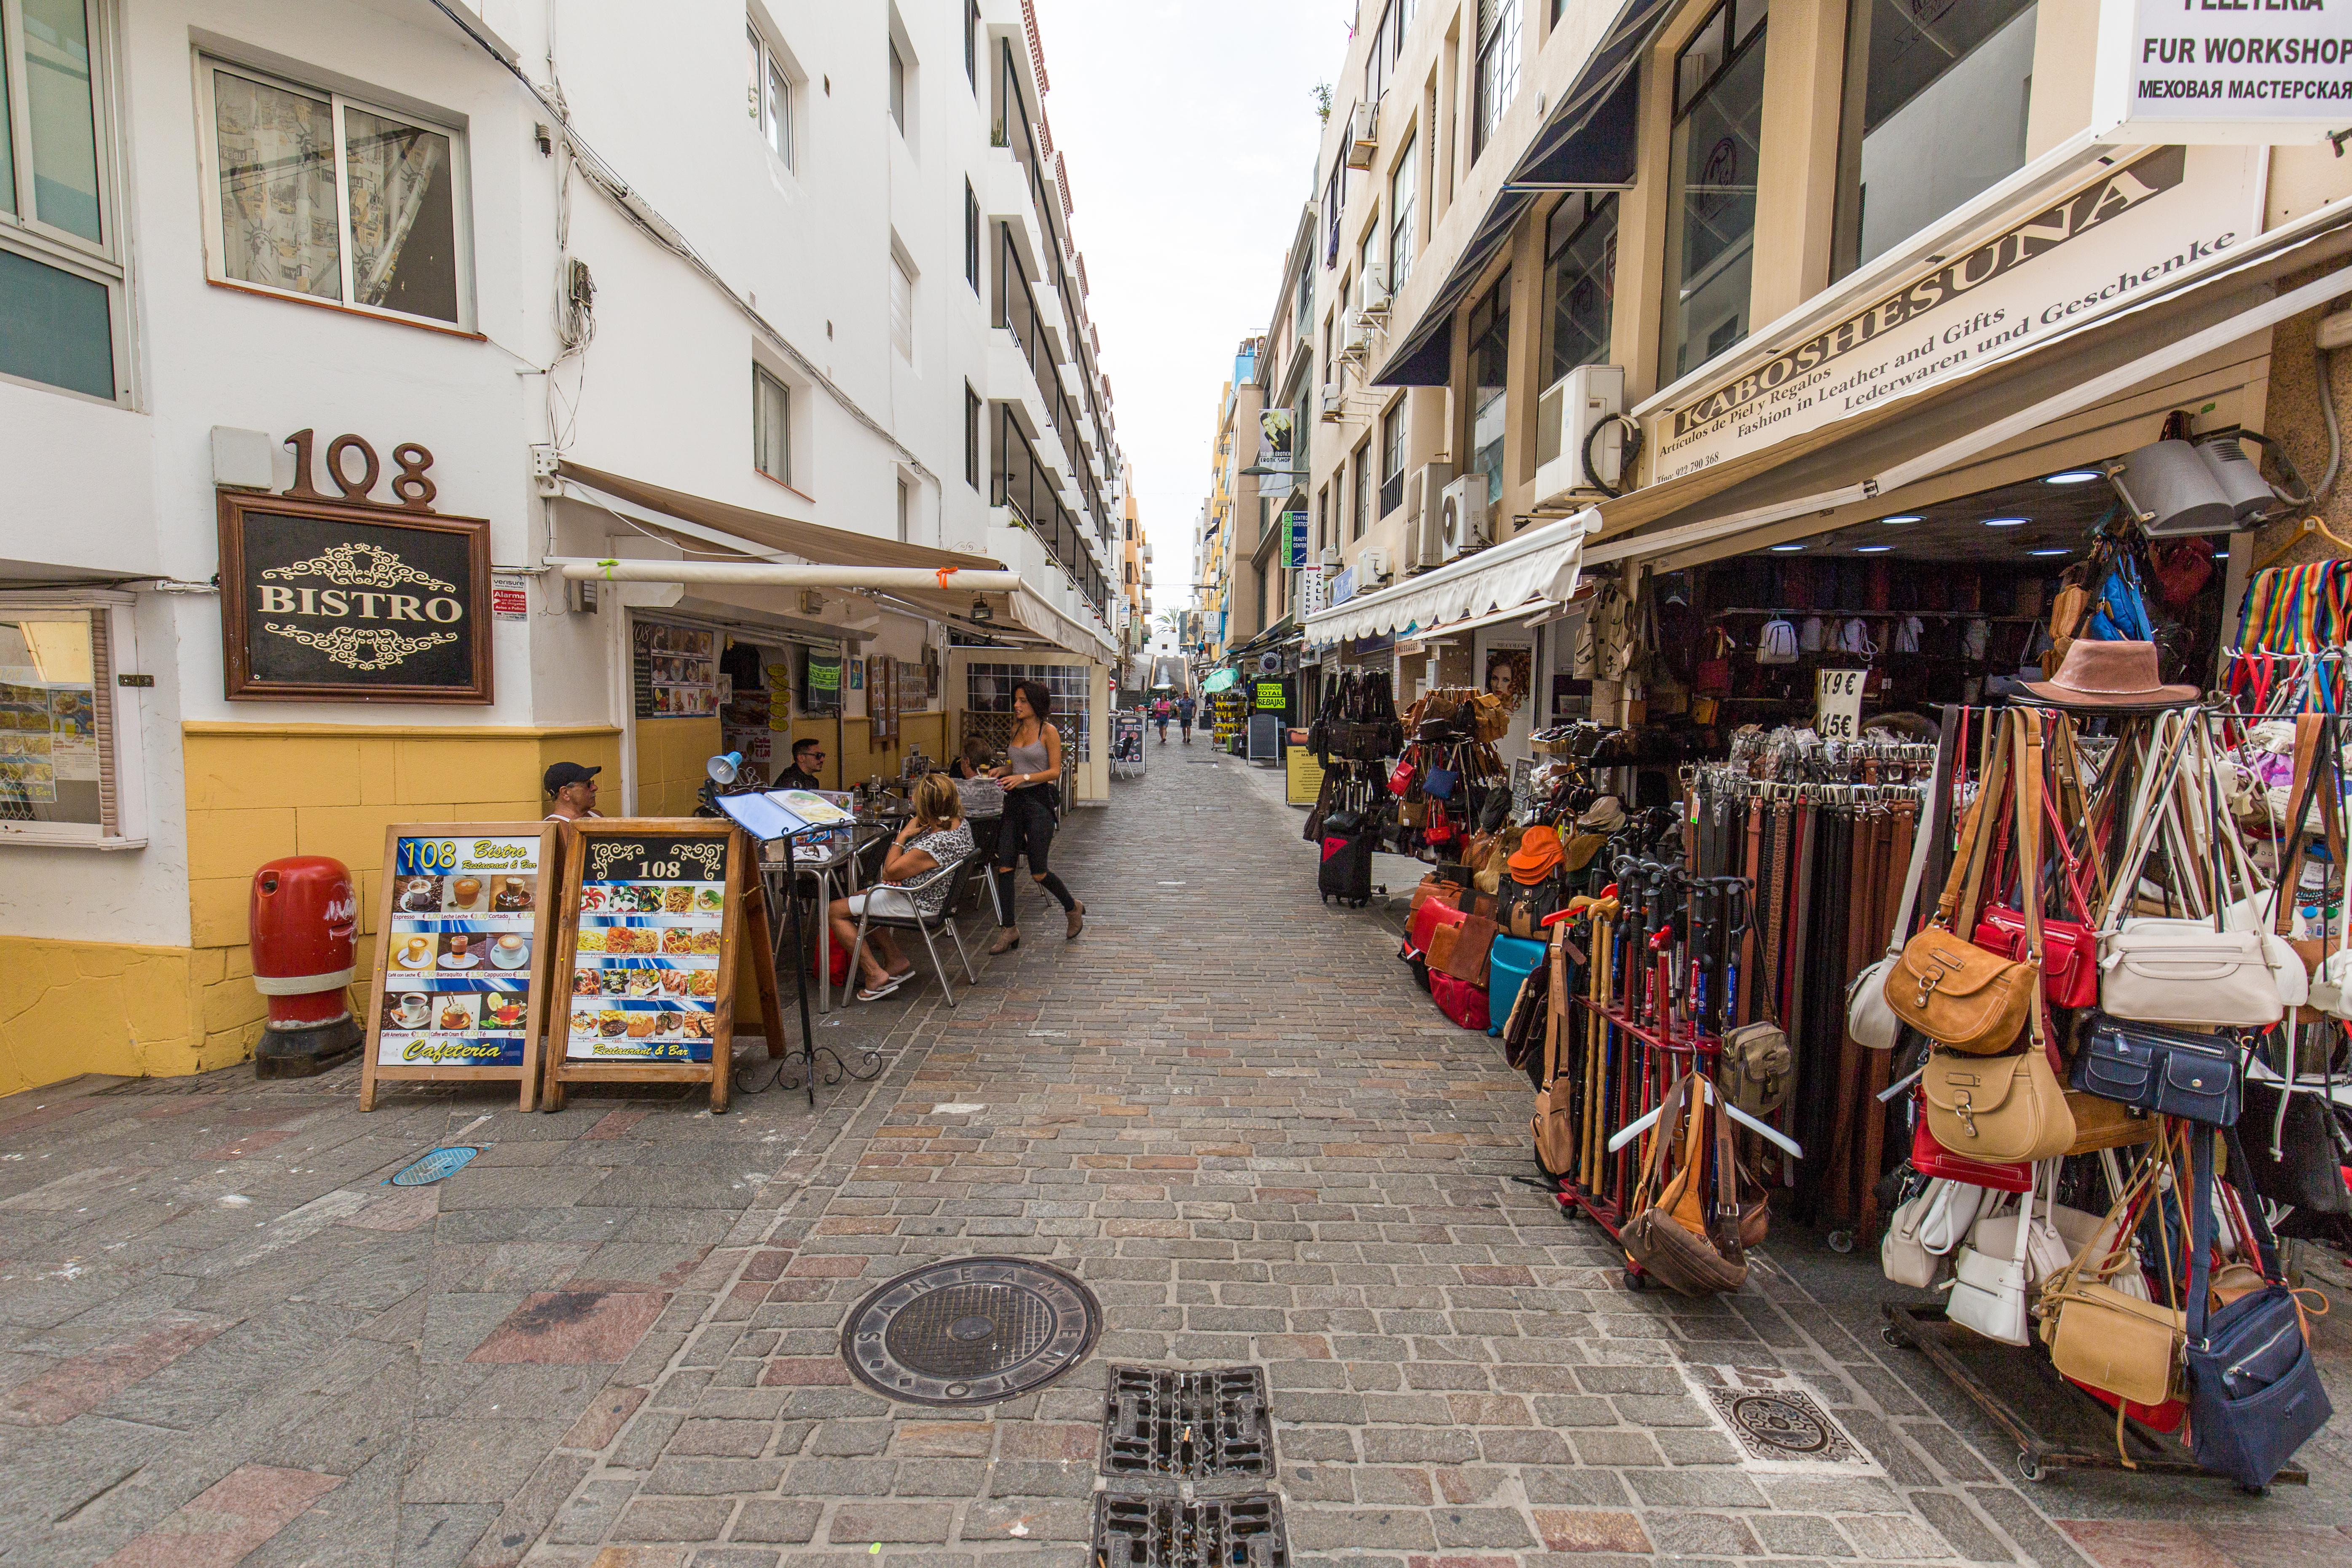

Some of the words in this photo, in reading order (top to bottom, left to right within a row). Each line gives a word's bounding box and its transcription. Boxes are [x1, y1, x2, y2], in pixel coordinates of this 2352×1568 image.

[2143, 38, 2196, 64] FUR
[2204, 38, 2352, 64] WORKSHOP
[2138, 80, 2223, 99] МЕХОВАЯ
[2228, 80, 2352, 99] МАСТЕРСКАЯ
[1682, 170, 2159, 433] KABOSHESUNA
[1844, 349, 1968, 410] Lederwaren
[1977, 316, 2030, 351] und
[2040, 231, 2236, 324] Geschenke
[1737, 407, 1791, 438] Fashion
[1797, 396, 1813, 410] in
[1818, 364, 1888, 402] Leather
[1895, 335, 1936, 366] and
[1942, 308, 2006, 343] Gifts
[1659, 426, 1708, 458] Artículos
[1711, 417, 1726, 433] de
[1730, 402, 1754, 424] Piel
[1757, 399, 1767, 415] y
[1770, 368, 1831, 405] Regalos
[282, 428, 437, 514] 108
[1676, 464, 1688, 477] 922
[1690, 458, 1703, 472] 790
[1705, 451, 1719, 466] 368
[1283, 512, 1292, 562] AZAHAR
[256, 584, 463, 623] BISTRO
[1398, 643, 1418, 654] MASSAGES
[1257, 698, 1285, 707] REBAJAS
[405, 841, 456, 868] 108
[473, 839, 527, 859] Bistro
[461, 860, 508, 870] Restaurant
[510, 860, 518, 869] &
[520, 860, 537, 869] Bar
[638, 861, 681, 878] 108
[402, 1039, 502, 1063] Cafetería
[593, 1043, 652, 1056] Restaurant
[654, 1044, 665, 1055] &
[668, 1045, 689, 1056] Bar
[858, 1267, 1082, 1398] SANEAMIENTO
